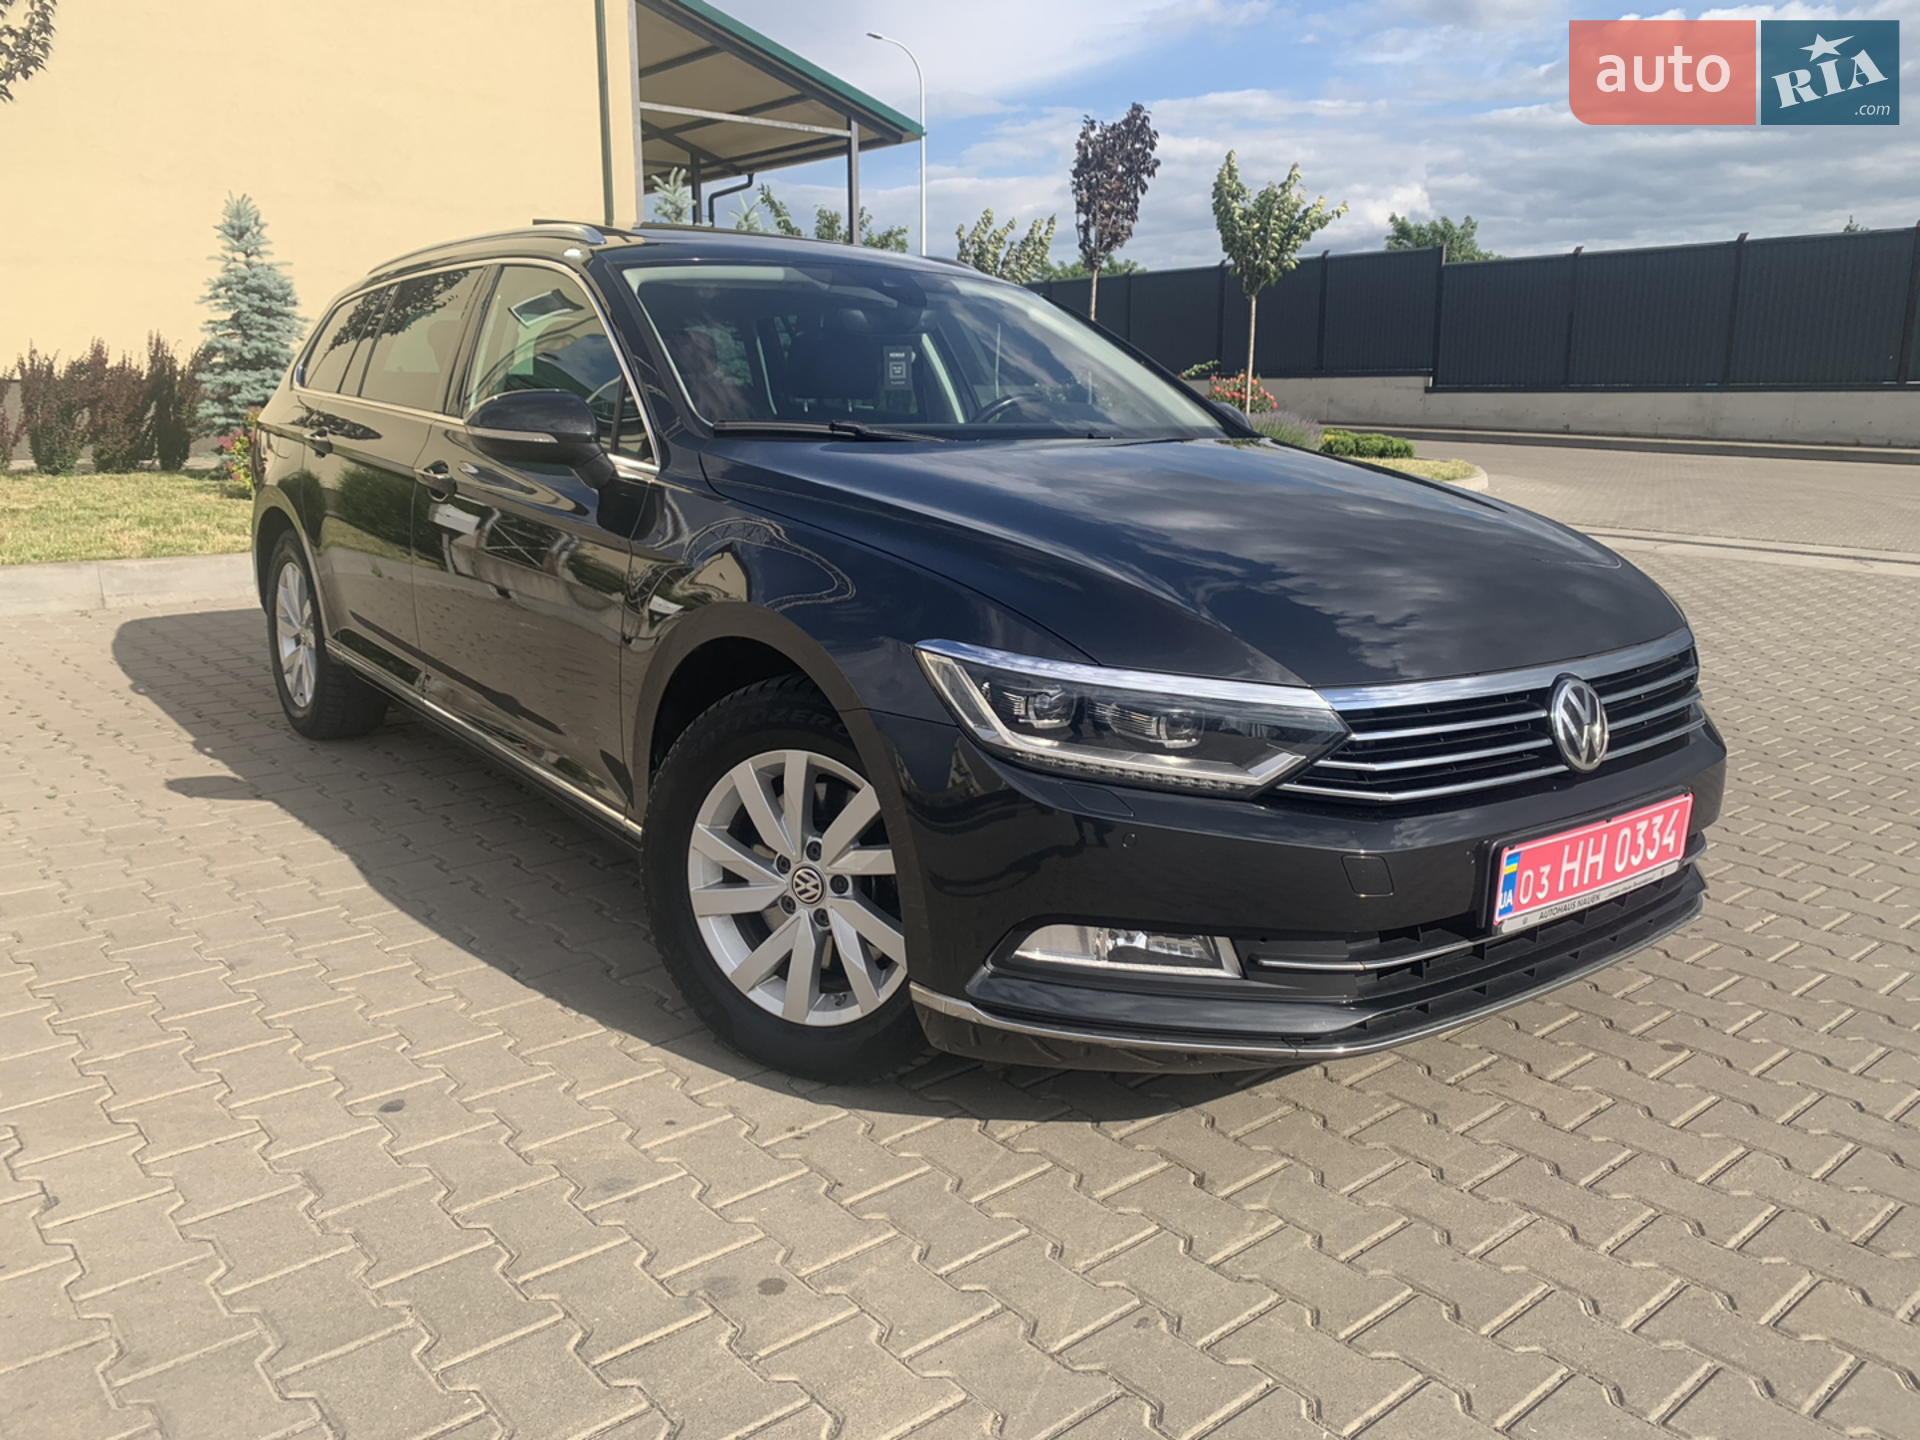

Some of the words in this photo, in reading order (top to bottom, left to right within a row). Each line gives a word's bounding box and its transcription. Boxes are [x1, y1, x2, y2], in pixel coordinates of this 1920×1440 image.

[1518, 864, 1551, 905] 03
[1558, 833, 1608, 892] HH
[1614, 808, 1680, 874] 0334
[1499, 889, 1513, 910] UA
[1538, 901, 1577, 920] AUTOHAUS
